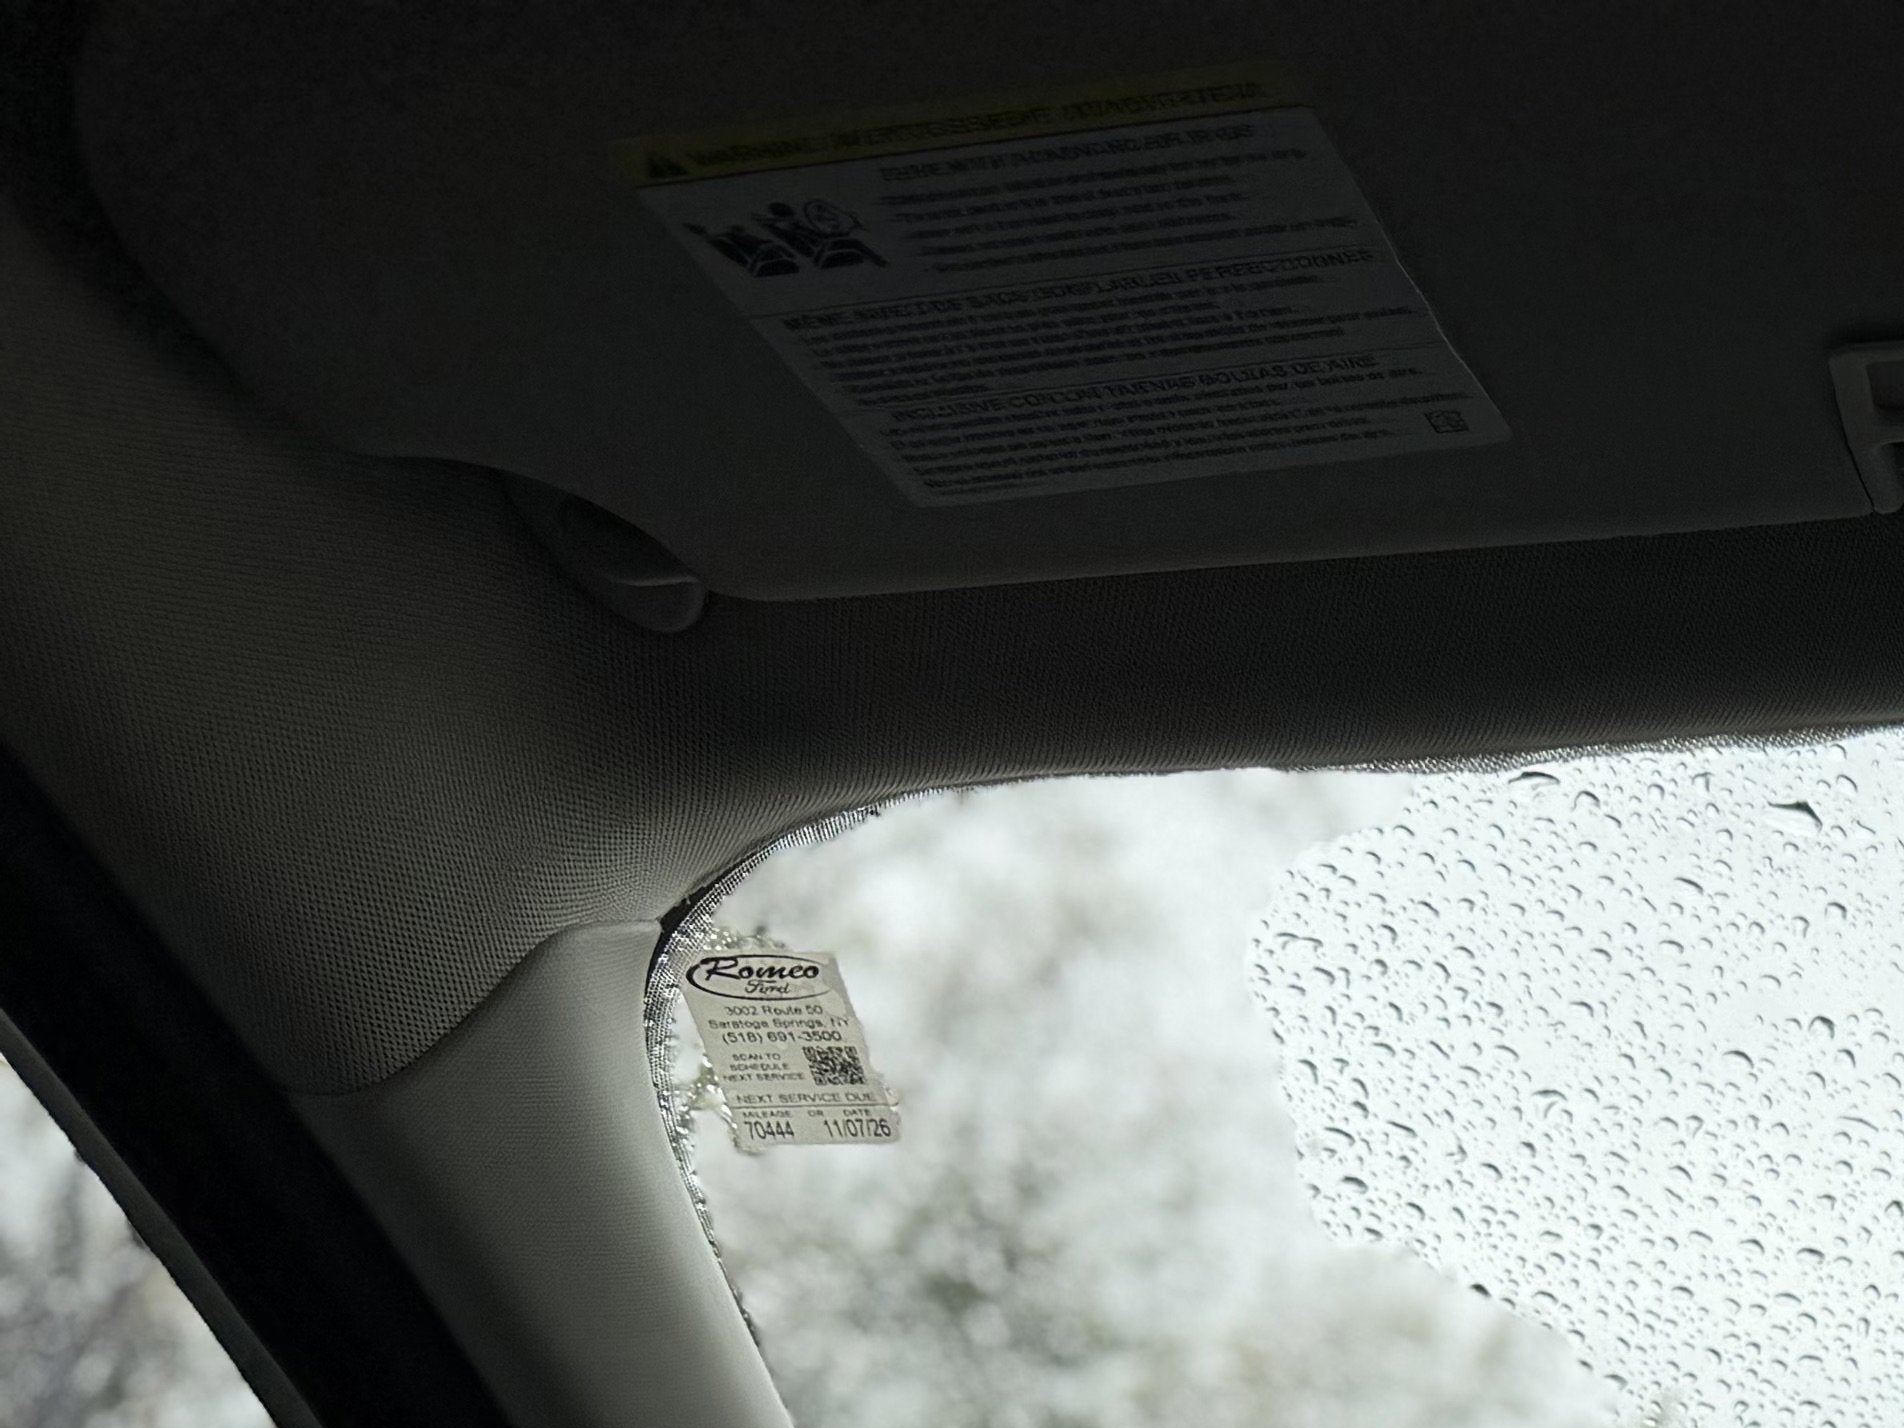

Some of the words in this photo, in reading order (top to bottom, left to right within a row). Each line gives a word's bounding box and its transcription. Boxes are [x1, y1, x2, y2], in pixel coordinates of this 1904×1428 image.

[702, 958, 819, 981] Romeo
[725, 1006, 758, 1016] 3002
[761, 1006, 802, 1016] Route
[806, 1005, 823, 1015] 50
[709, 1020, 769, 1031] Saratoga
[723, 1032, 763, 1044] (518)
[767, 1031, 842, 1043] 691-3500
[729, 1063, 790, 1071] SCHEDULE
[756, 1072, 805, 1081] SERVICE
[736, 1094, 774, 1103] NEXT
[780, 1093, 841, 1103] SERVICE
[845, 1093, 877, 1102] DUE
[742, 1110, 792, 1118] MILEAGE
[843, 1109, 872, 1117] DATE
[745, 1121, 794, 1140] 70444
[824, 1119, 892, 1137] 11/07/26
